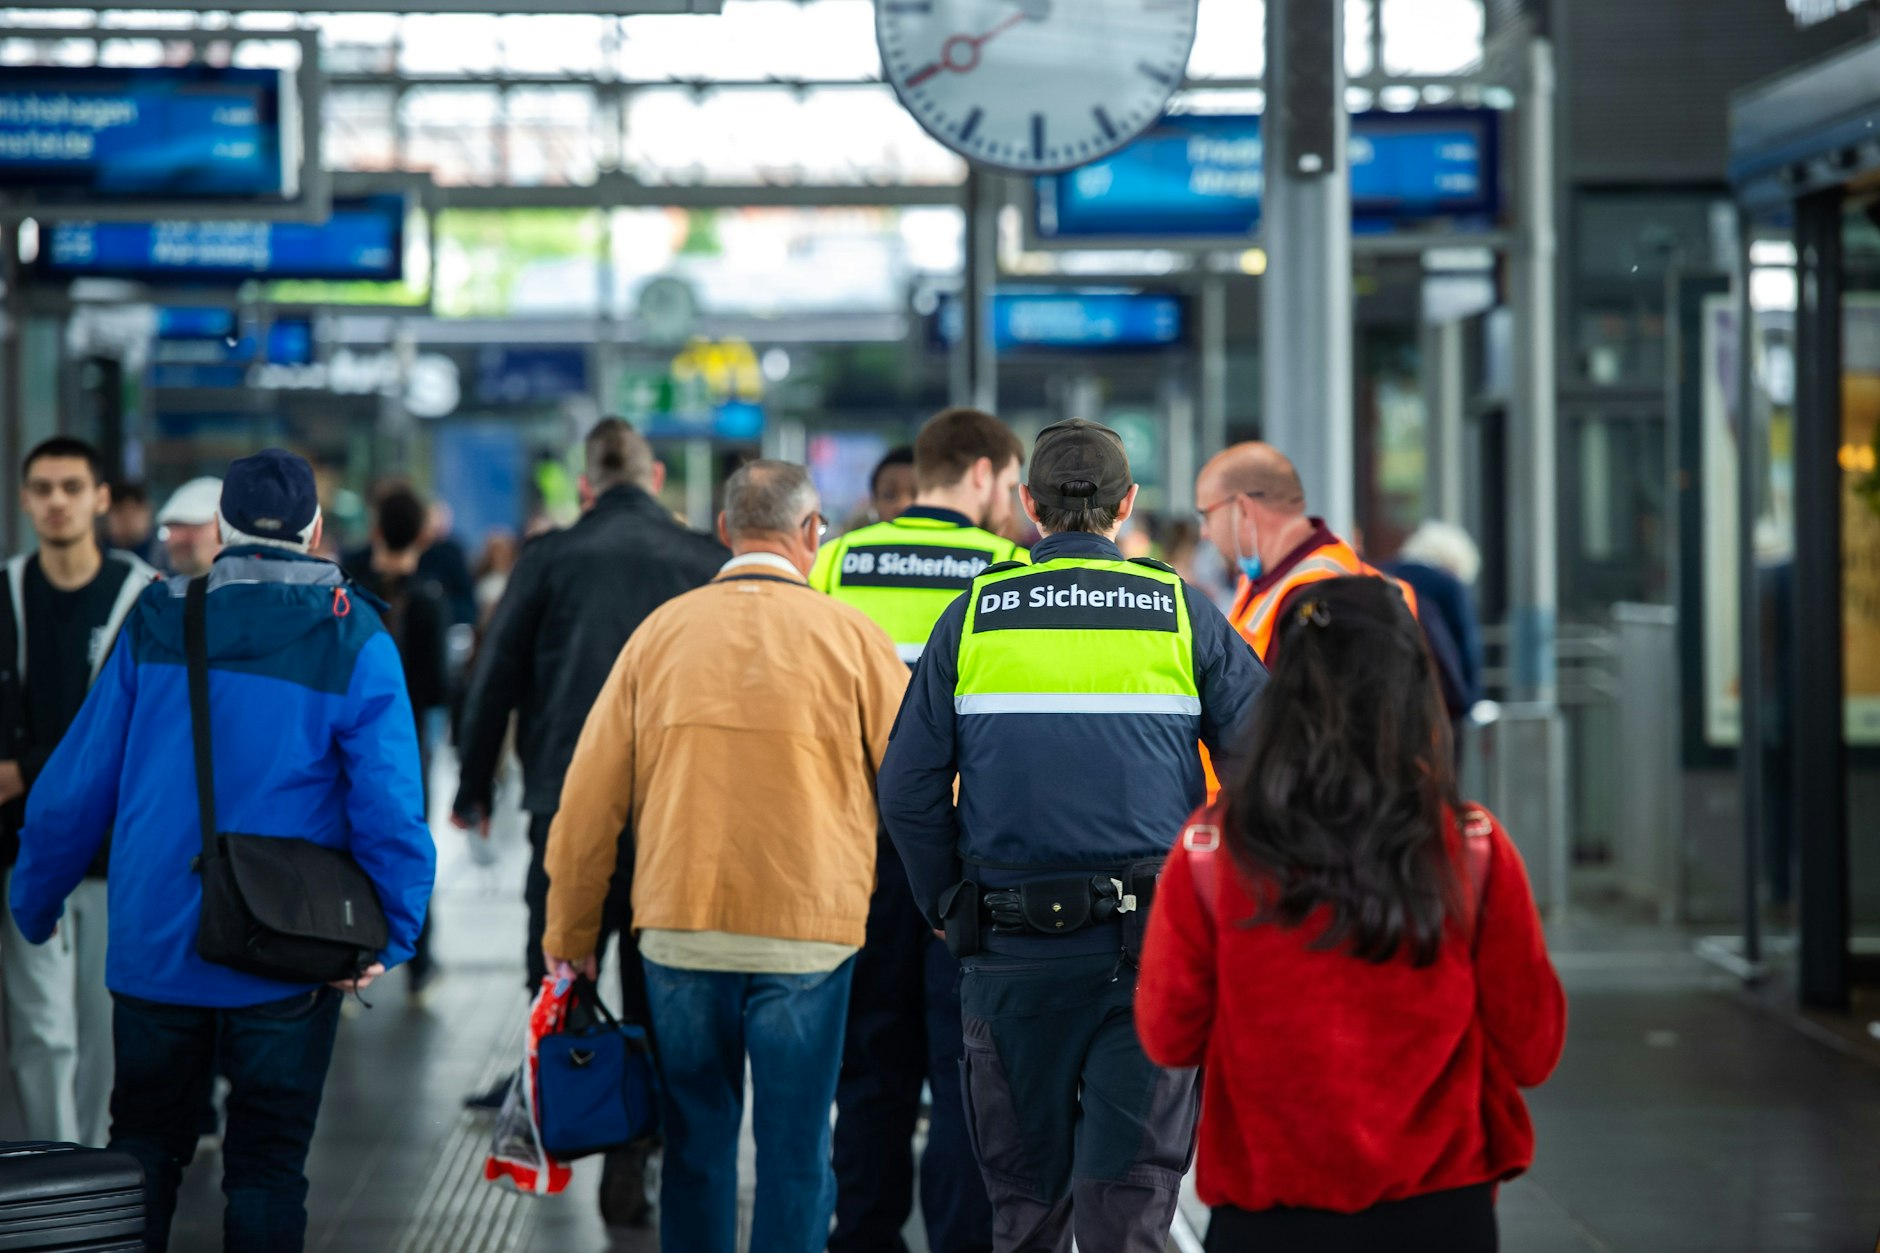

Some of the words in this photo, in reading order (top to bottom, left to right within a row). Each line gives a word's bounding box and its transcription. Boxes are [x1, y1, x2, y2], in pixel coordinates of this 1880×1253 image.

[843, 553, 875, 574] DB
[980, 590, 1021, 614] DB
[1029, 584, 1174, 613] Sicherheit
